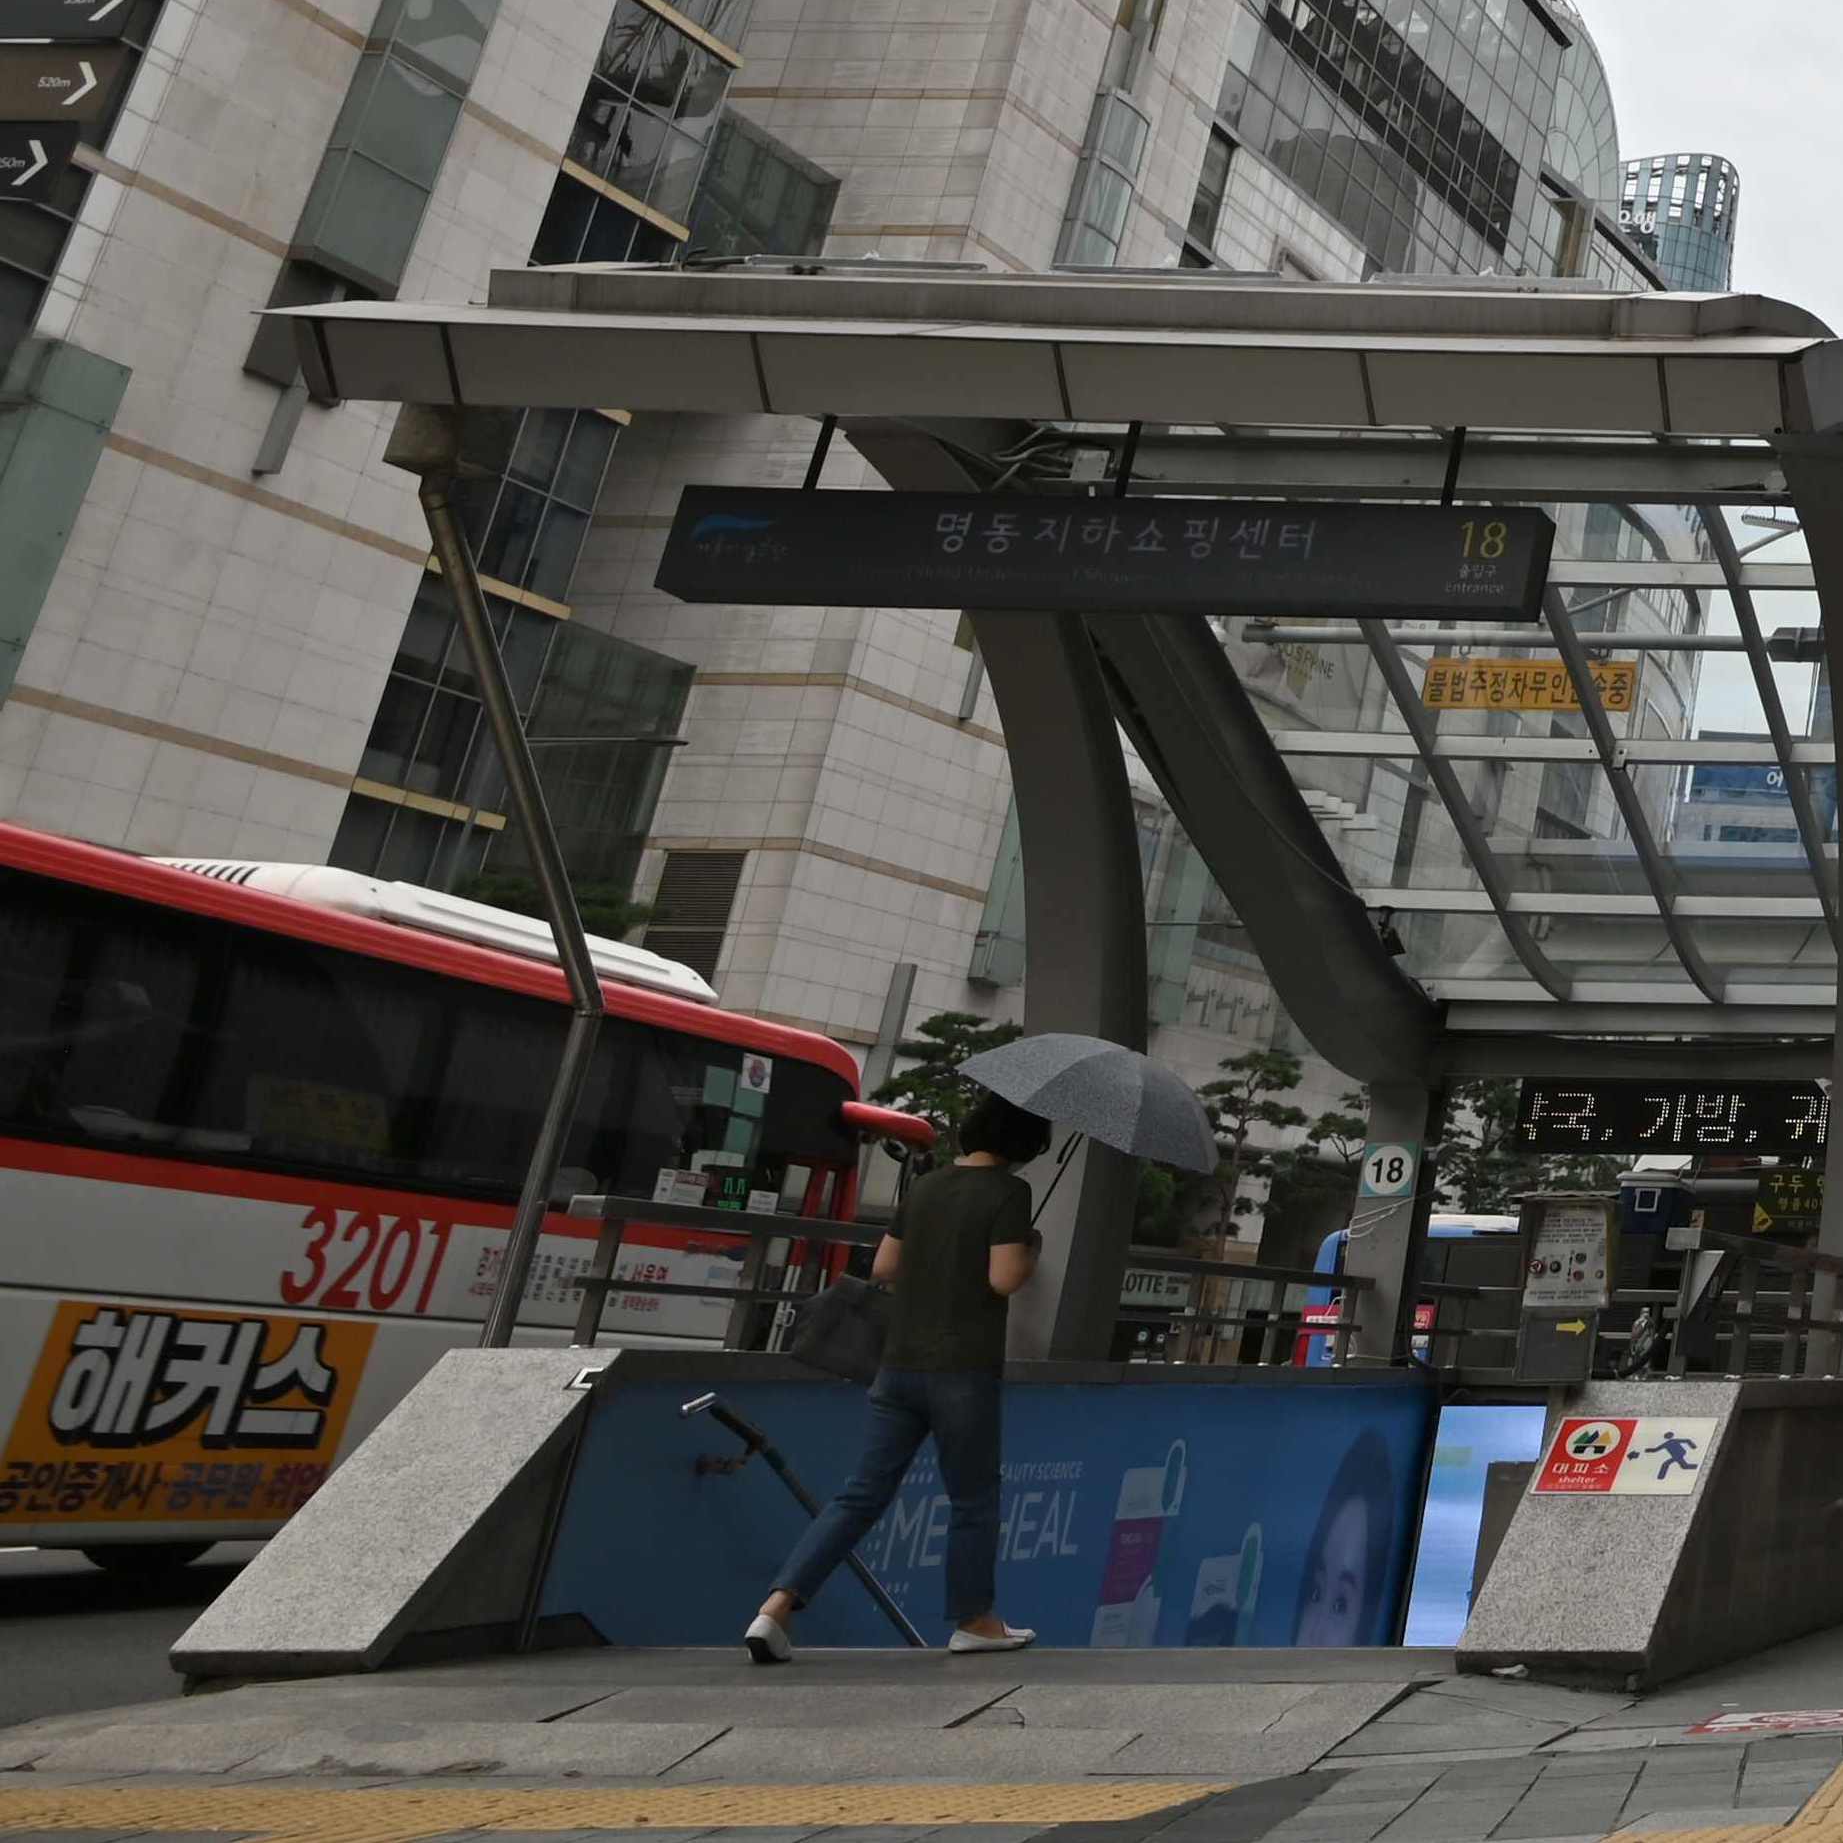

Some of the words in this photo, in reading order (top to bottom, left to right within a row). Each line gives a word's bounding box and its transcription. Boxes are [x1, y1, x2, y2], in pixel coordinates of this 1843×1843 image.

[934, 509, 1319, 556] 명동지하쇼핑센터
[1458, 518, 1508, 560] 18
[1456, 563, 1499, 580] 출입구
[1443, 580, 1506, 596] entrance
[1370, 1156, 1406, 1184] 18
[279, 1206, 451, 1315] 3201
[49, 1309, 339, 1449] 해커스
[1557, 1475, 1599, 1485] shelter
